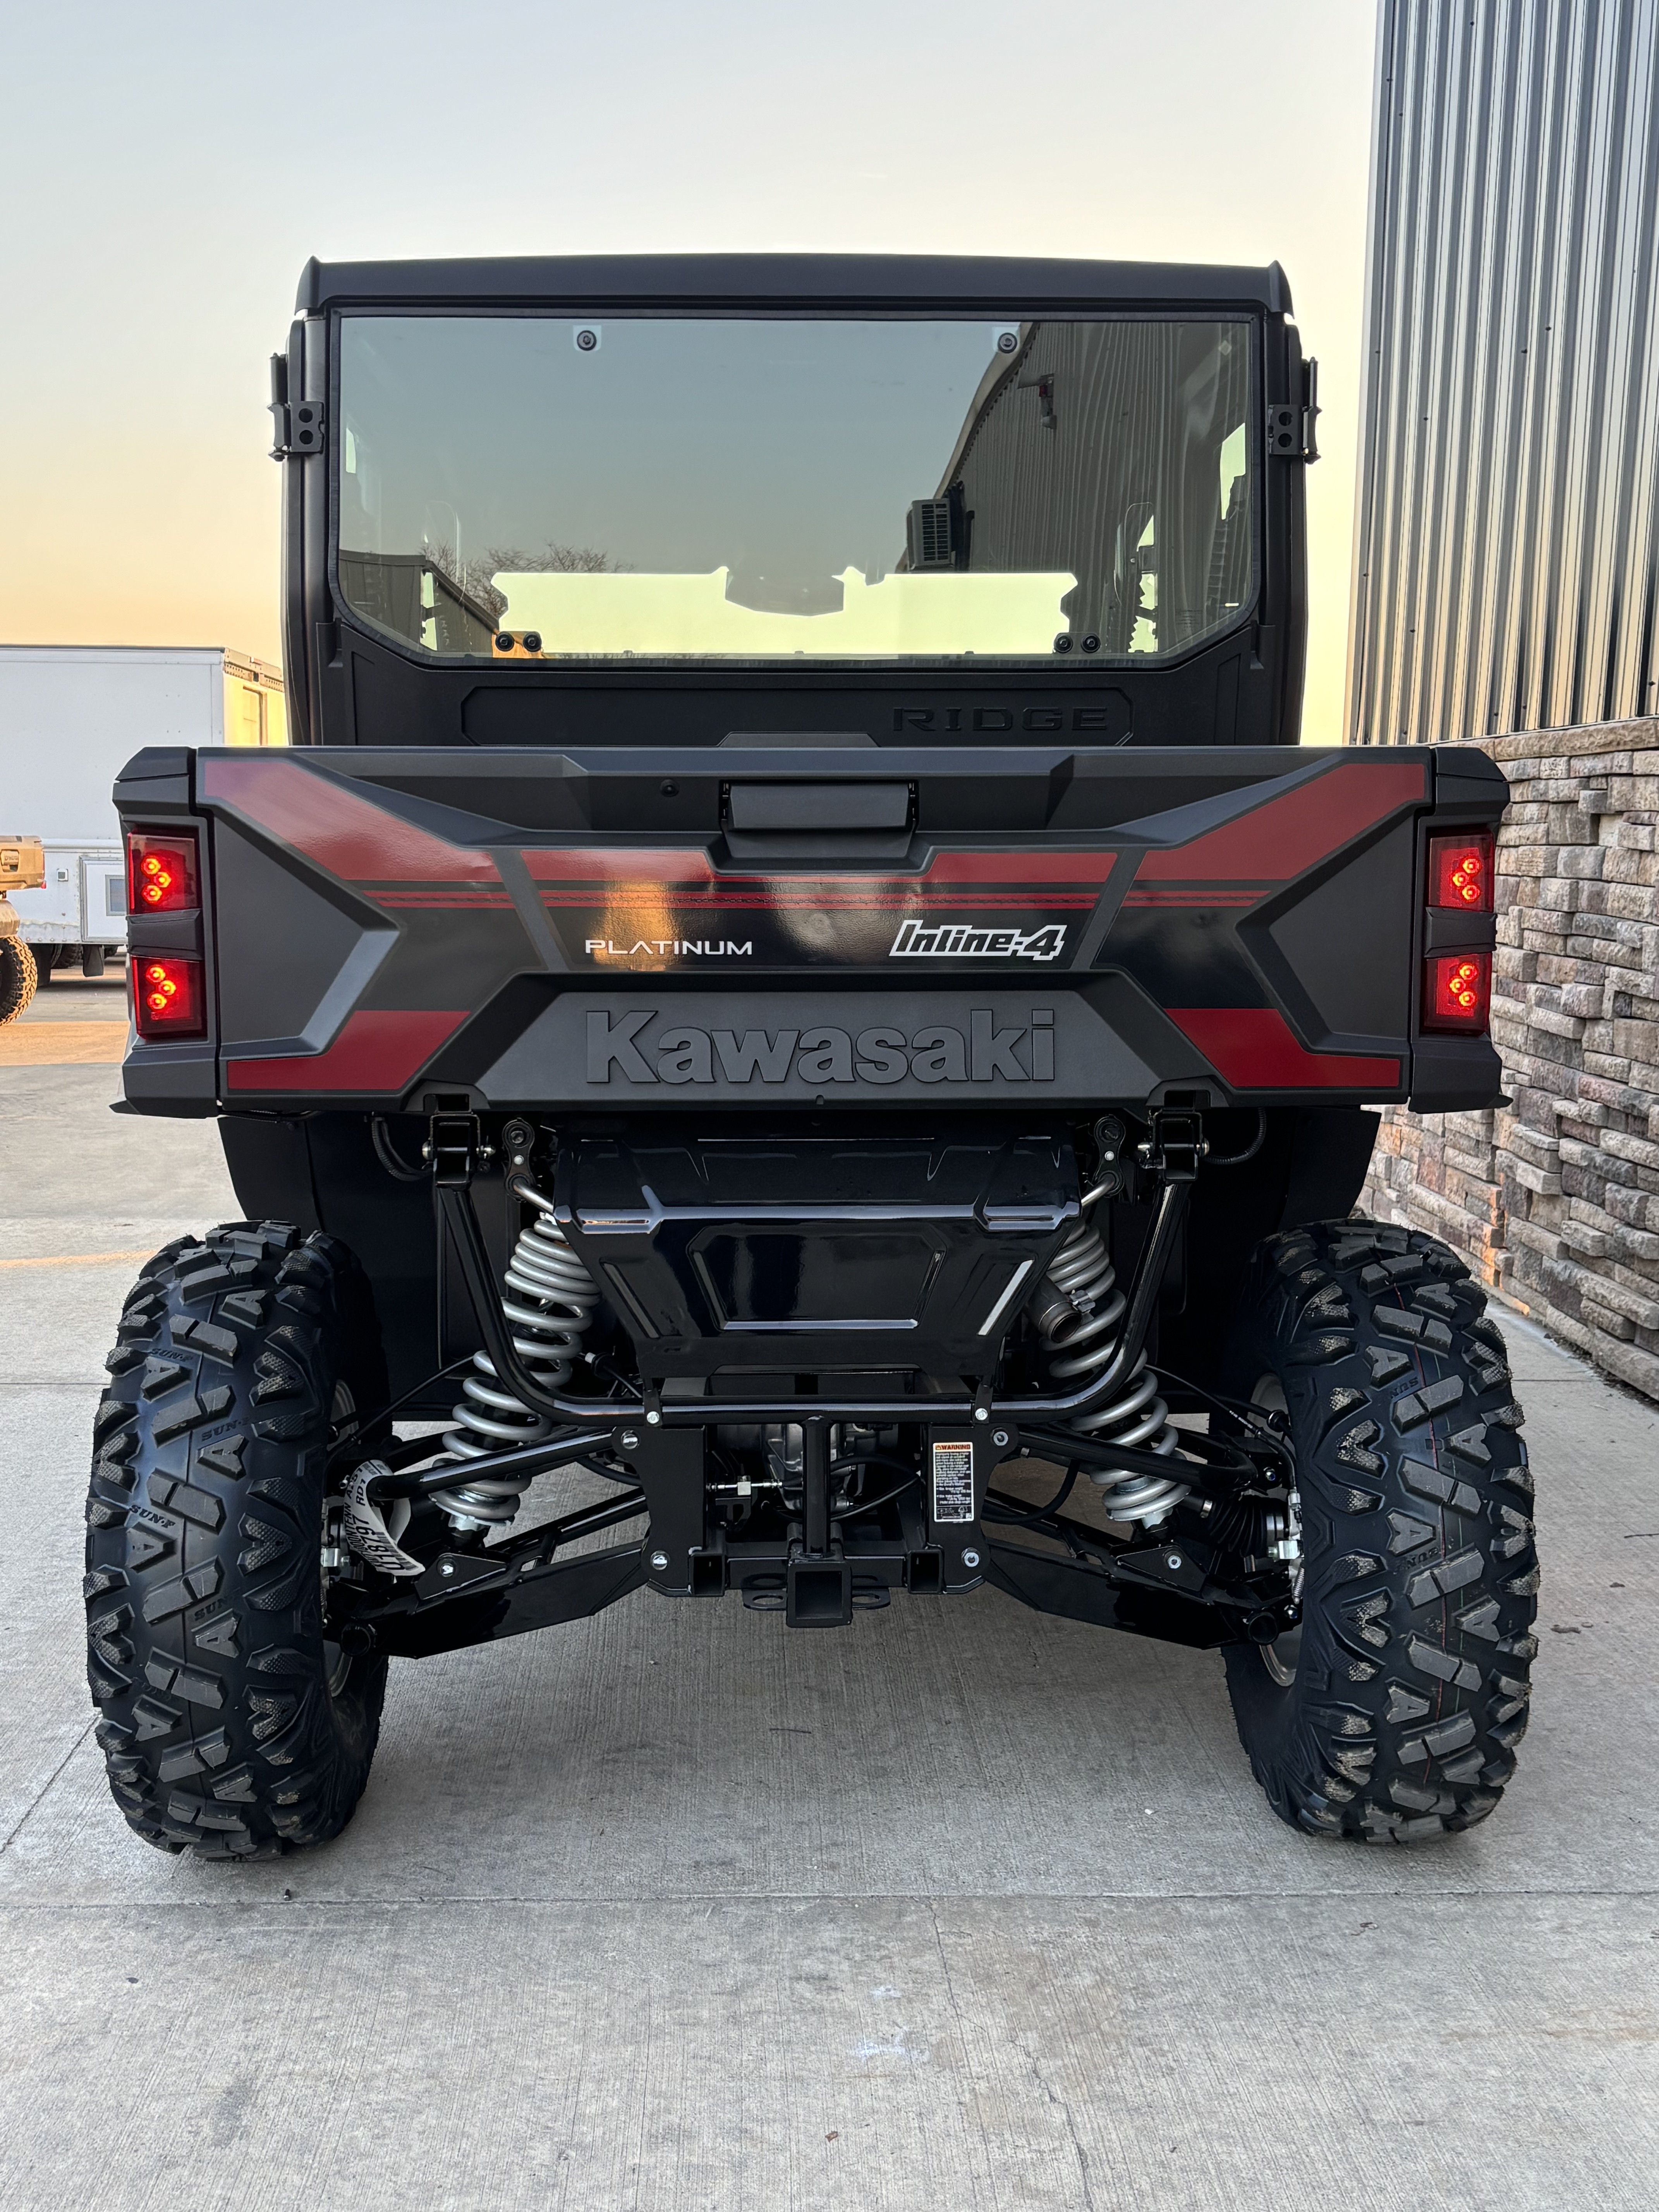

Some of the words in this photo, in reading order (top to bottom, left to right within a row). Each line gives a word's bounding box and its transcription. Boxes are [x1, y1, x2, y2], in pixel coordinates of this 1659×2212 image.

[893, 707, 1108, 731] RIDGE
[585, 939, 752, 955] PLATINUM
[889, 919, 1067, 960] Inline-4
[586, 1008, 1055, 1084] Kawasaki
